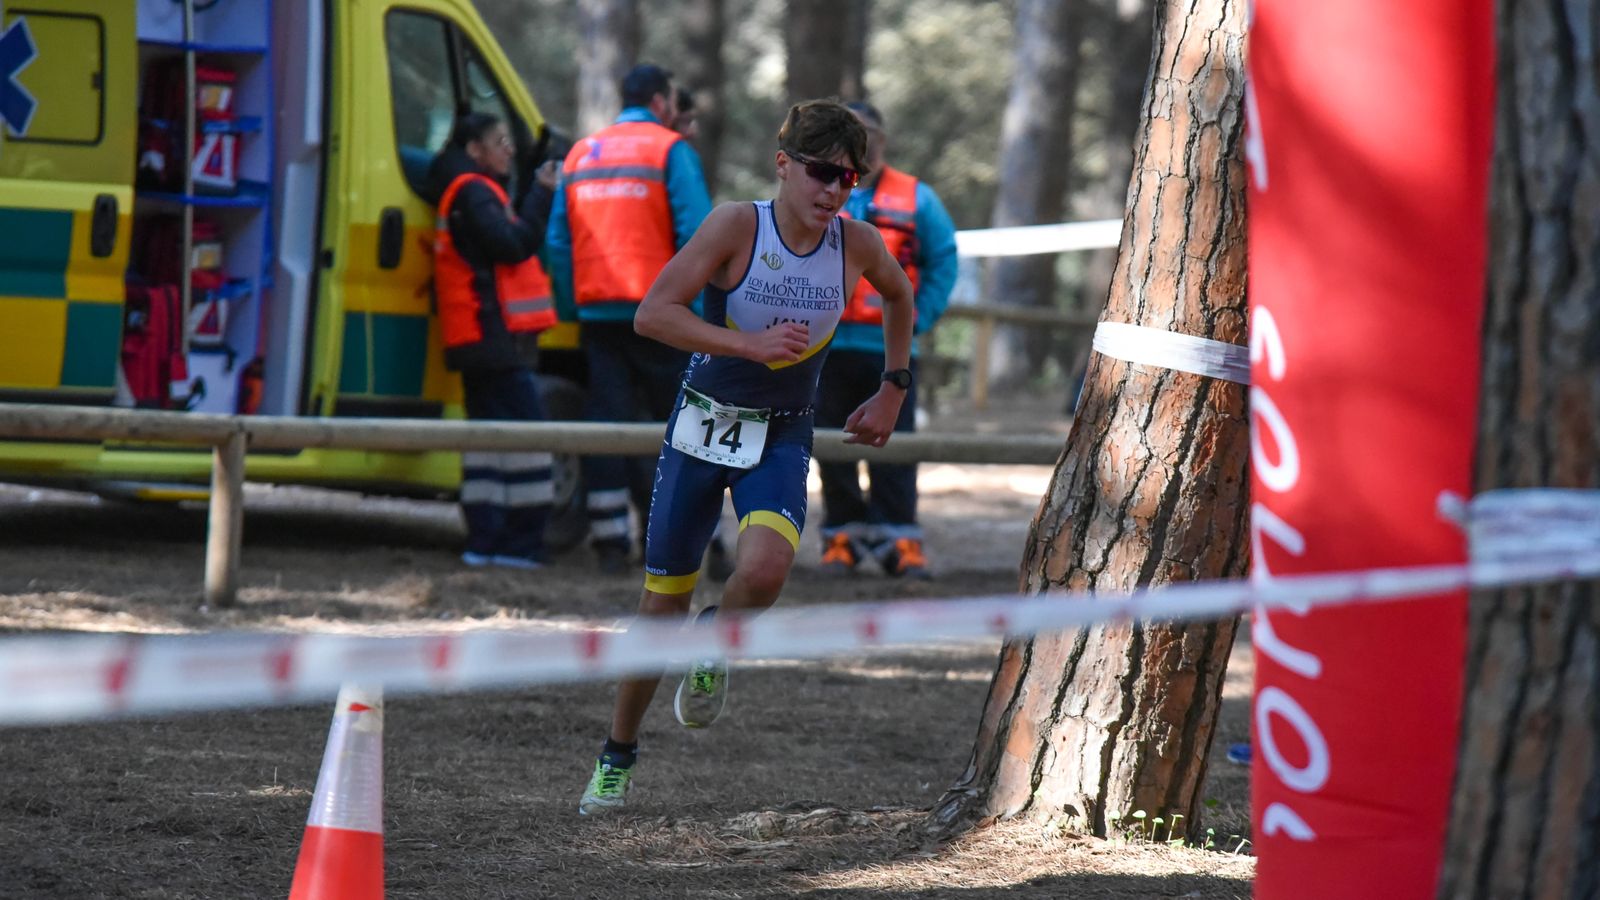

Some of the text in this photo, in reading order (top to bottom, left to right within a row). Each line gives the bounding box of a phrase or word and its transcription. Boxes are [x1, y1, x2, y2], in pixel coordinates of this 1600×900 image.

[747, 276, 840, 300] LOS MONTEROS
[784, 275, 811, 286] HOTEL
[744, 292, 840, 311] TRIATLON MARBELLA
[701, 417, 742, 454] 14
